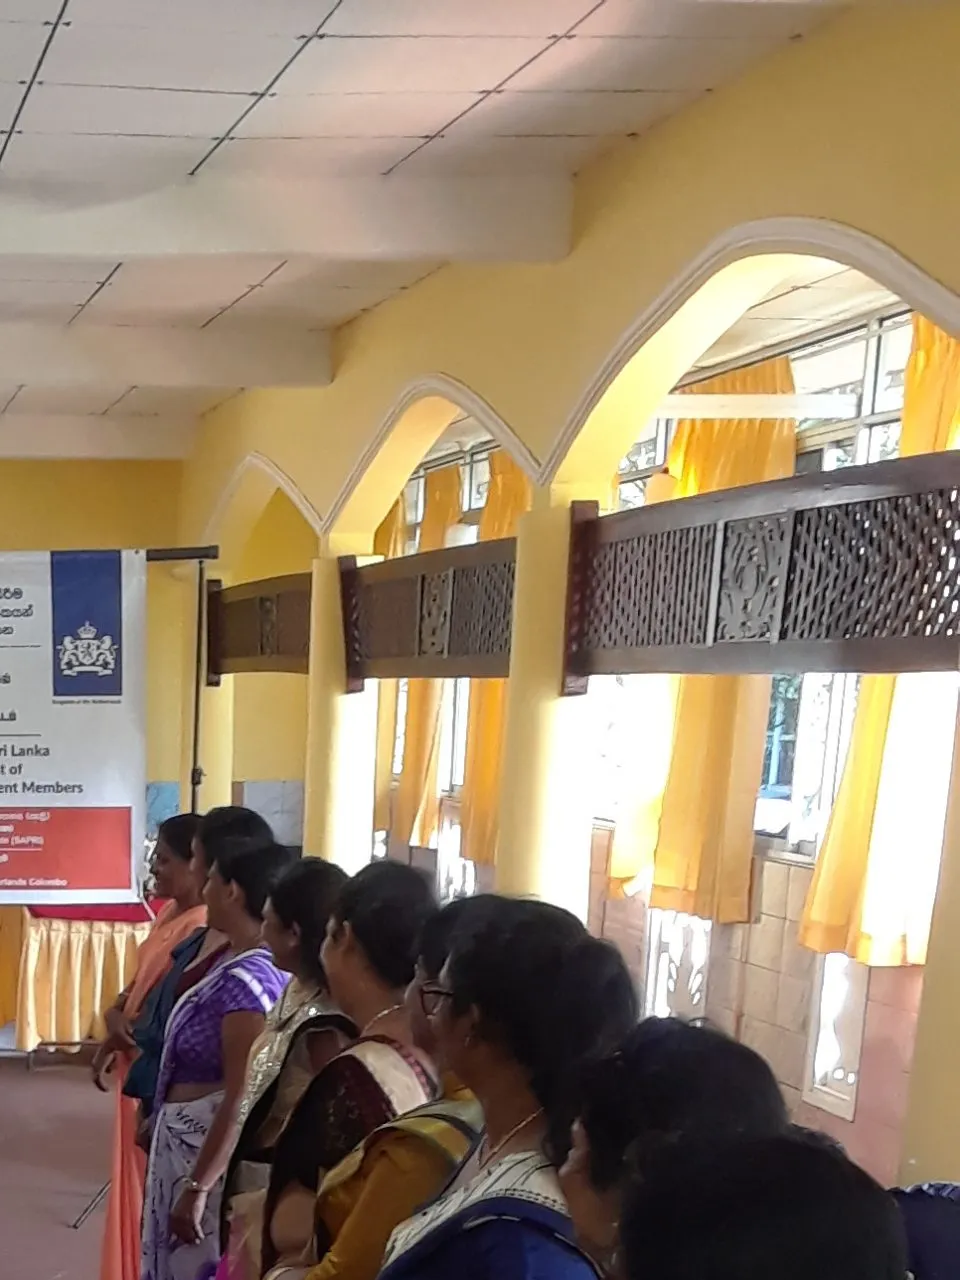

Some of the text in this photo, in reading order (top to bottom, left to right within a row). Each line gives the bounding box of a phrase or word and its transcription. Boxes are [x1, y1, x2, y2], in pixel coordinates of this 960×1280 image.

[11, 744, 50, 757] Lanka
[8, 762, 24, 776] of
[21, 780, 83, 794] Members
